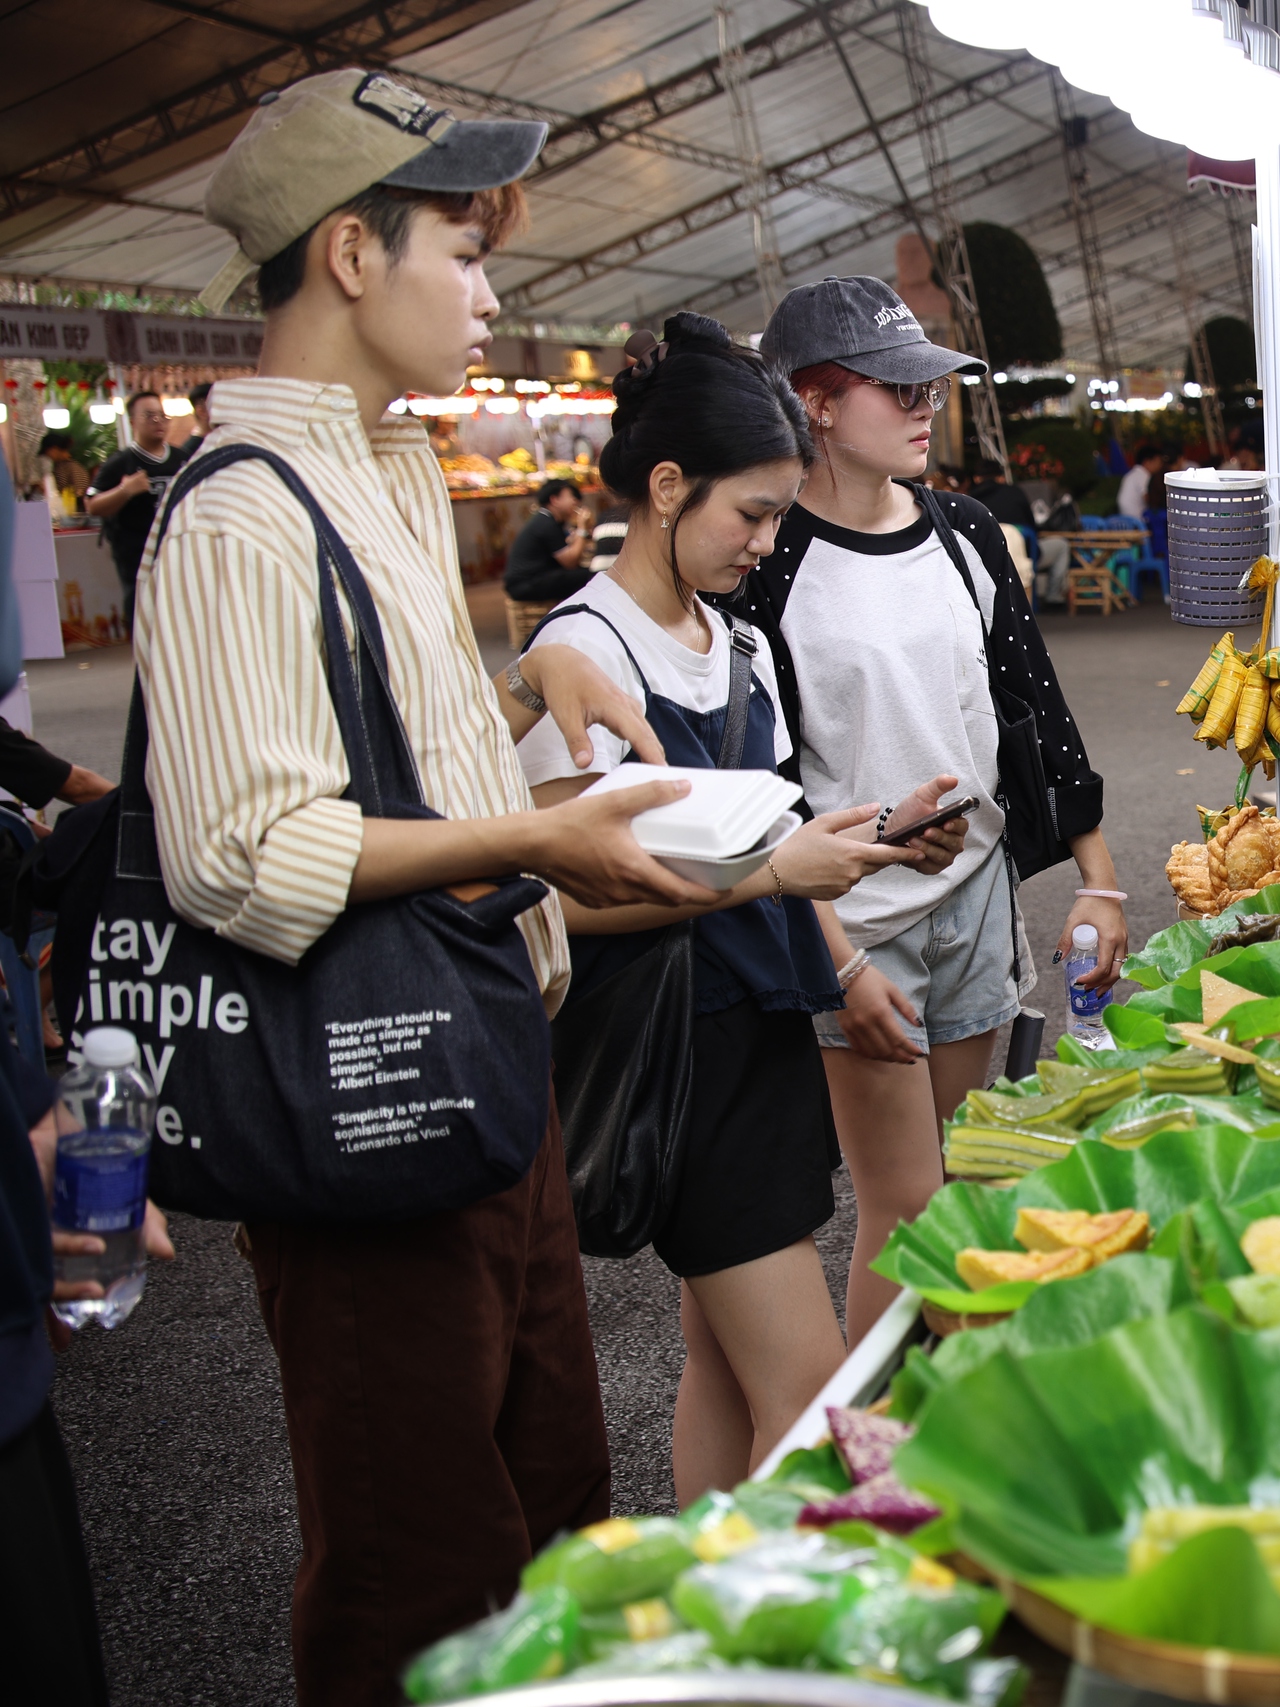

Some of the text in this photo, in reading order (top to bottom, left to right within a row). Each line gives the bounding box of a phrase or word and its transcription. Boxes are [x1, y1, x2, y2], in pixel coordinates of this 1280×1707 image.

[26, 321, 58, 349] KIM
[90, 911, 177, 976] tay
[75, 966, 250, 1039] imple
[395, 1011, 433, 1026] should
[436, 1011, 451, 1022] be
[328, 1026, 430, 1049] made as simple as
[329, 1040, 421, 1065] possible, but not
[338, 1077, 373, 1091] Albert
[375, 1069, 419, 1085] Einstein
[396, 1104, 406, 1116] is
[408, 1102, 426, 1114] the
[429, 1098, 475, 1112] ultimate
[345, 1137, 401, 1153] Leonardo
[403, 1133, 417, 1144] da
[420, 1127, 450, 1141] Vinci
